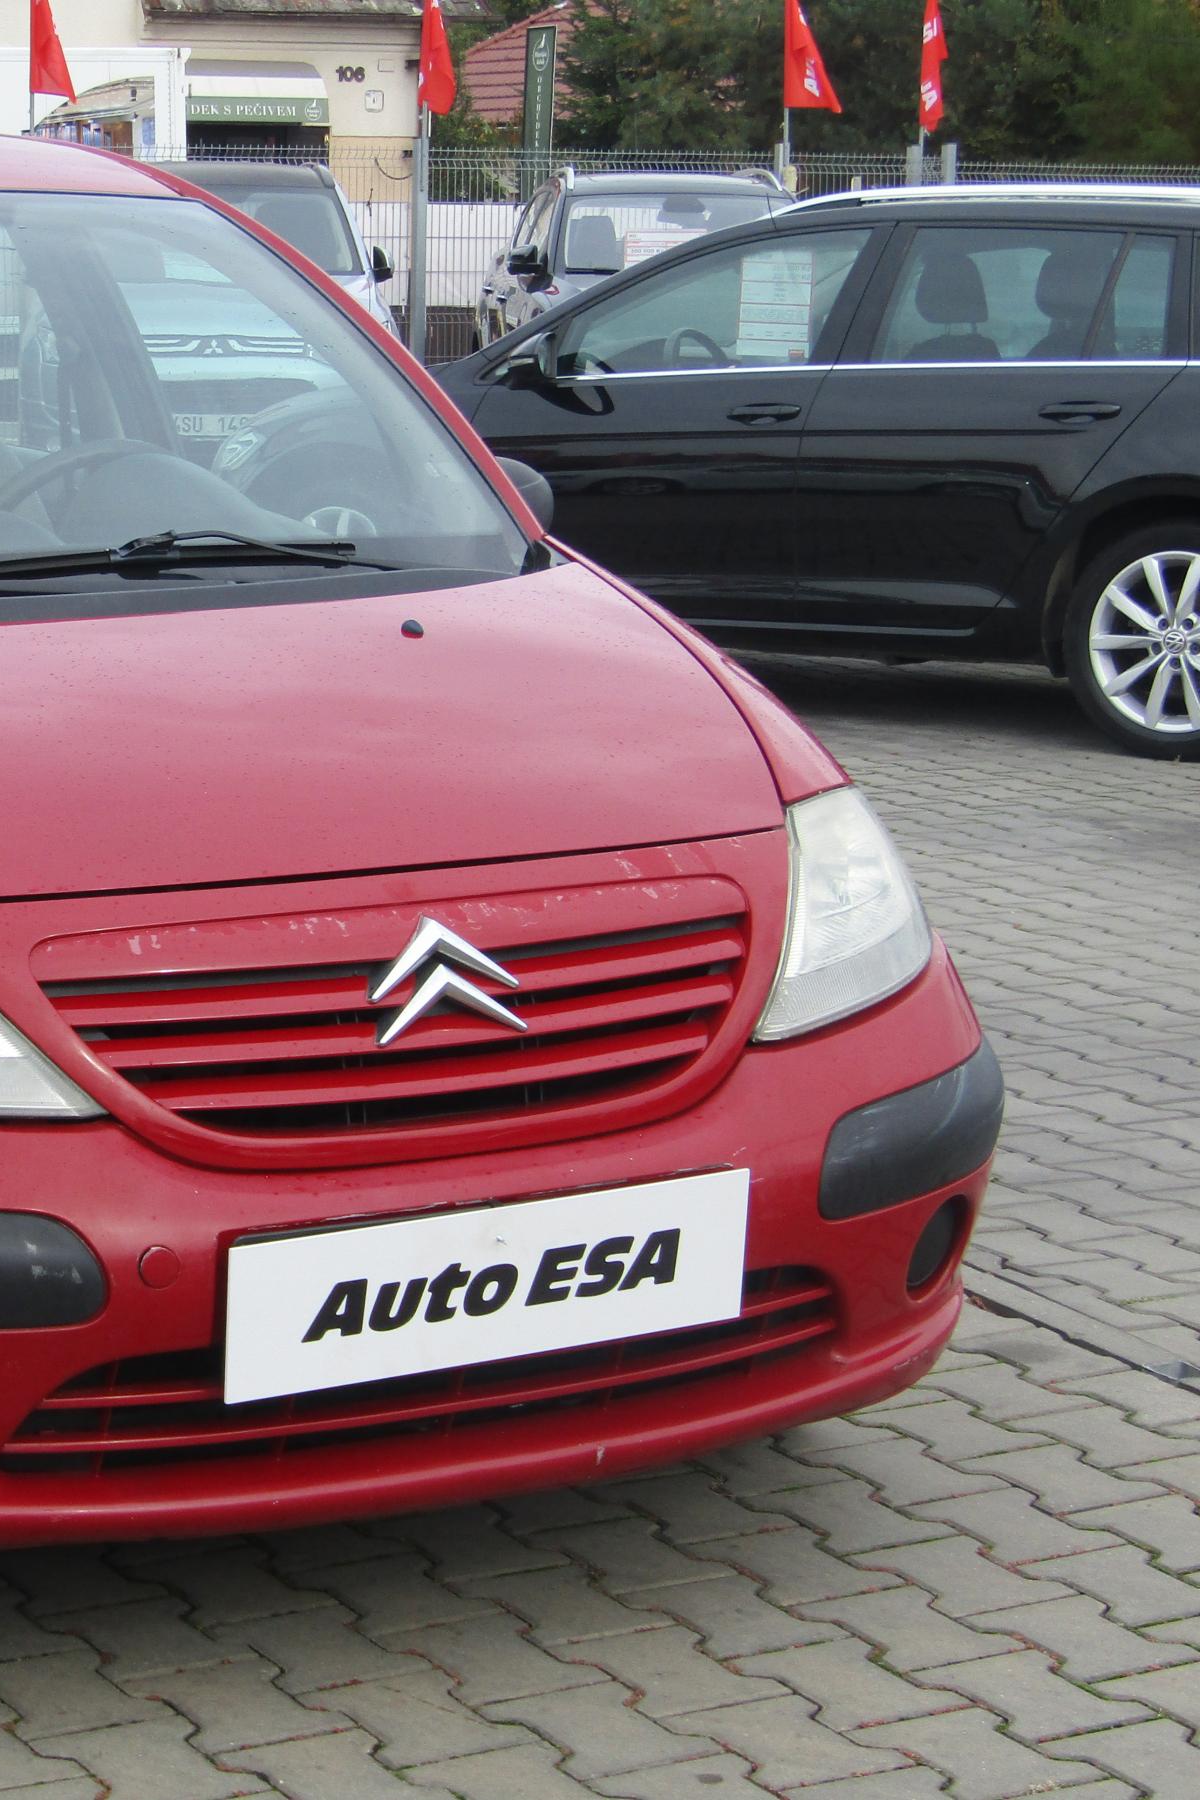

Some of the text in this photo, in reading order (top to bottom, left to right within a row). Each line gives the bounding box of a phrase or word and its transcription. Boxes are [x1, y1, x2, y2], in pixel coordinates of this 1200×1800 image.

[336, 66, 365, 83] 106
[223, 104, 232, 116] S
[236, 103, 297, 117] PEČIVEM
[301, 1228, 681, 1344] Auto ESA
